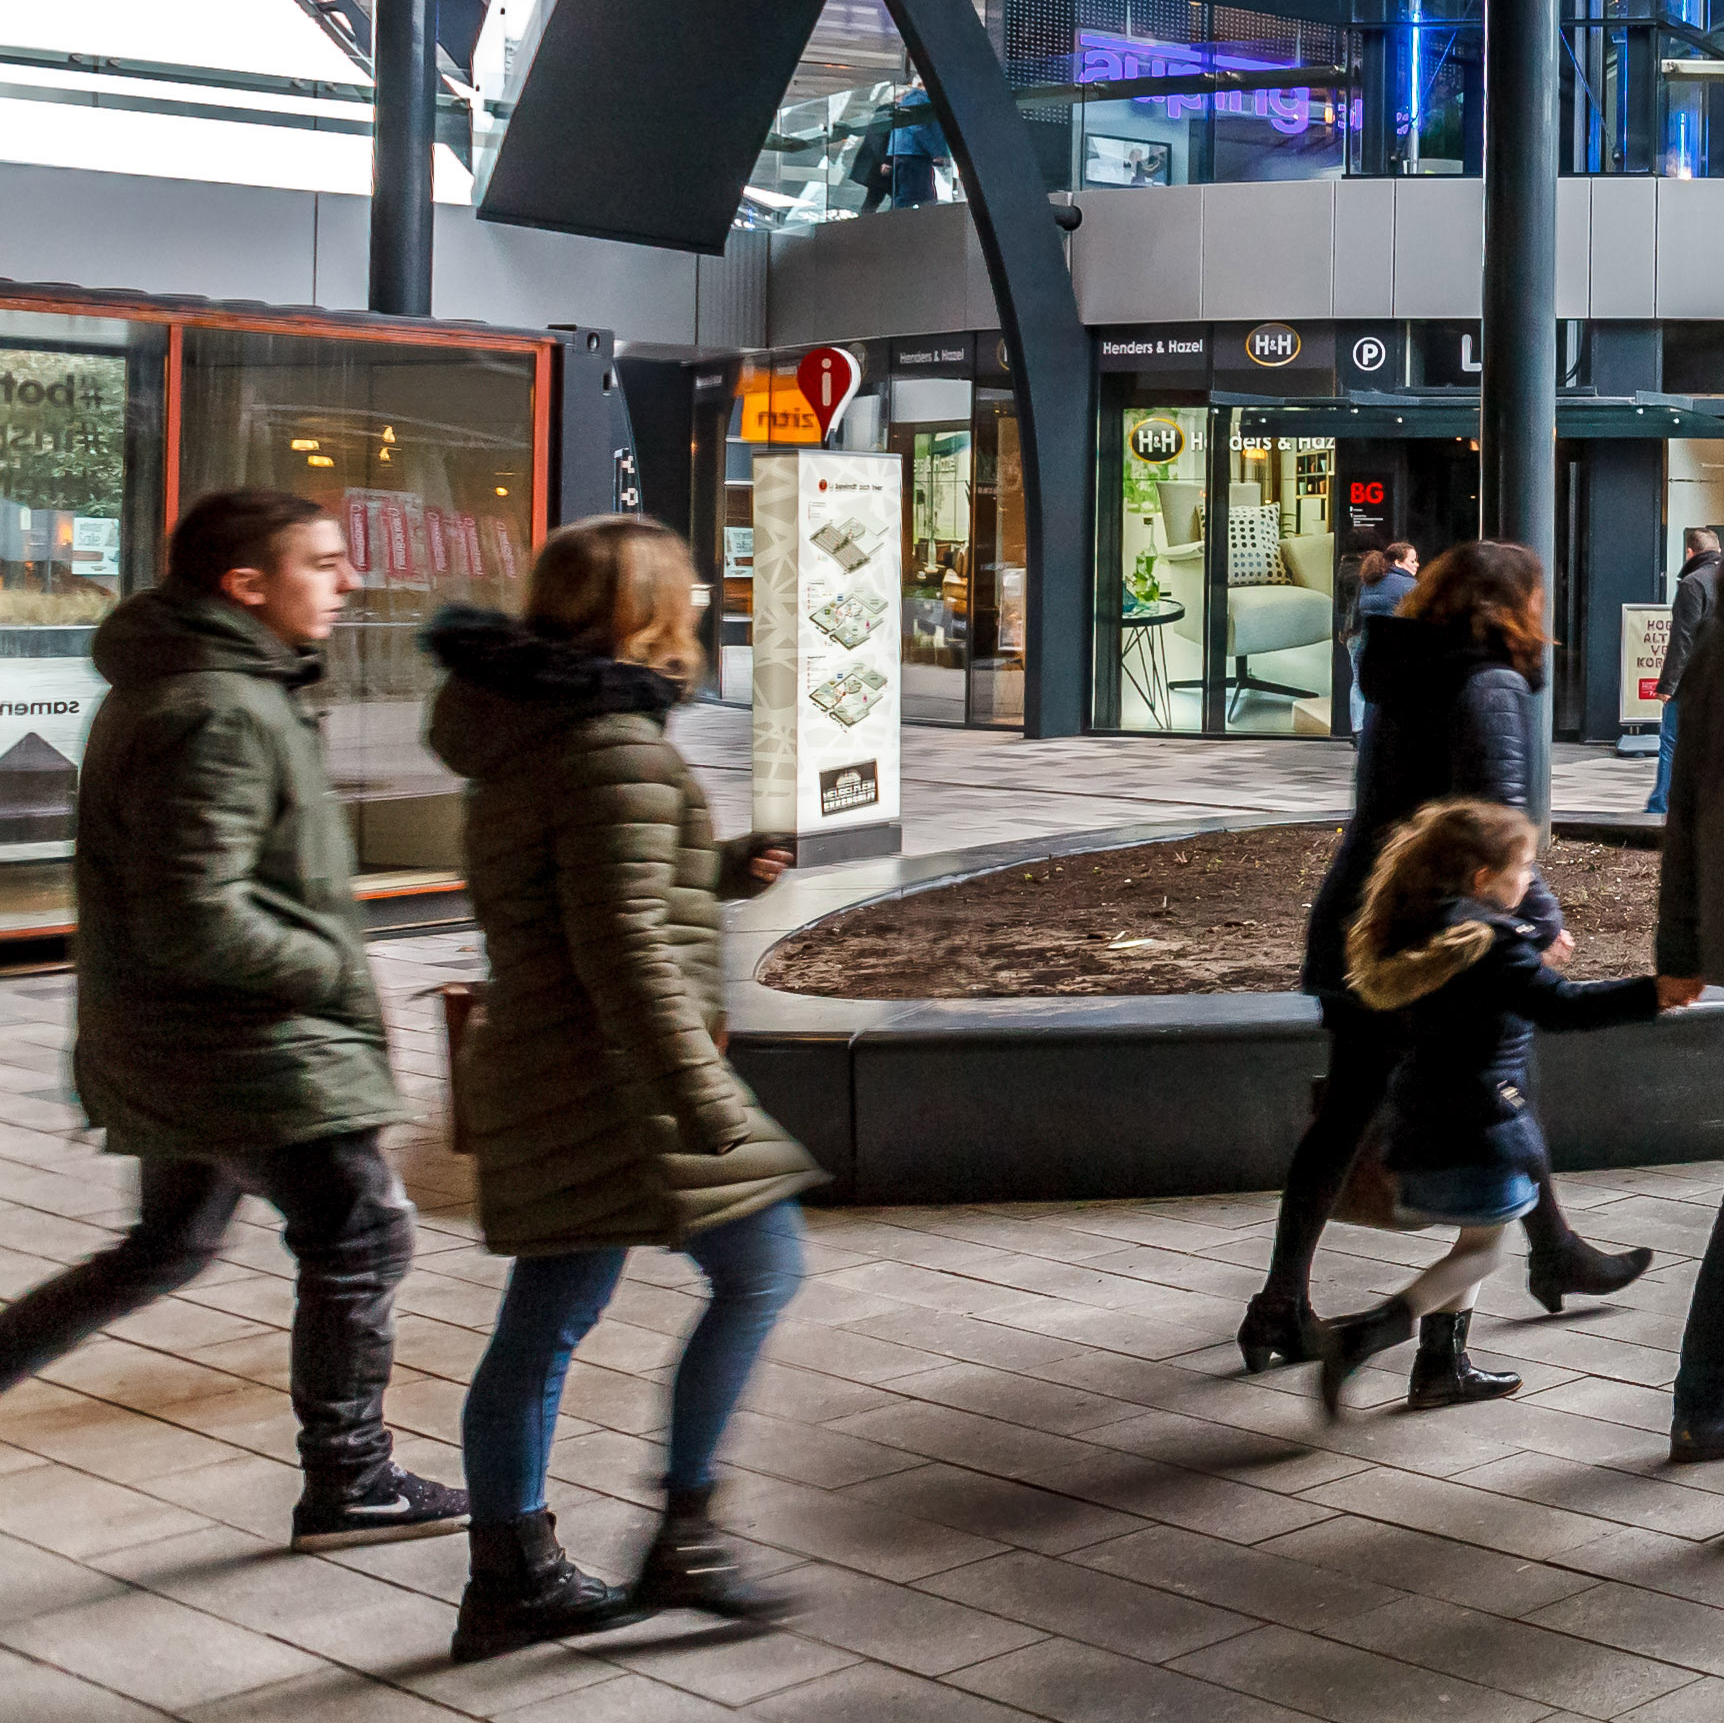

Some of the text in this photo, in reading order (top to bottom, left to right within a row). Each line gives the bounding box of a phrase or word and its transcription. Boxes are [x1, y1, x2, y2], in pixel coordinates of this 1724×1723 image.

[1103, 339, 1203, 355] Henders & Hazel
[1255, 334, 1292, 356] H&H
[1138, 429, 1177, 453] H&H
[1350, 482, 1384, 504] BG
